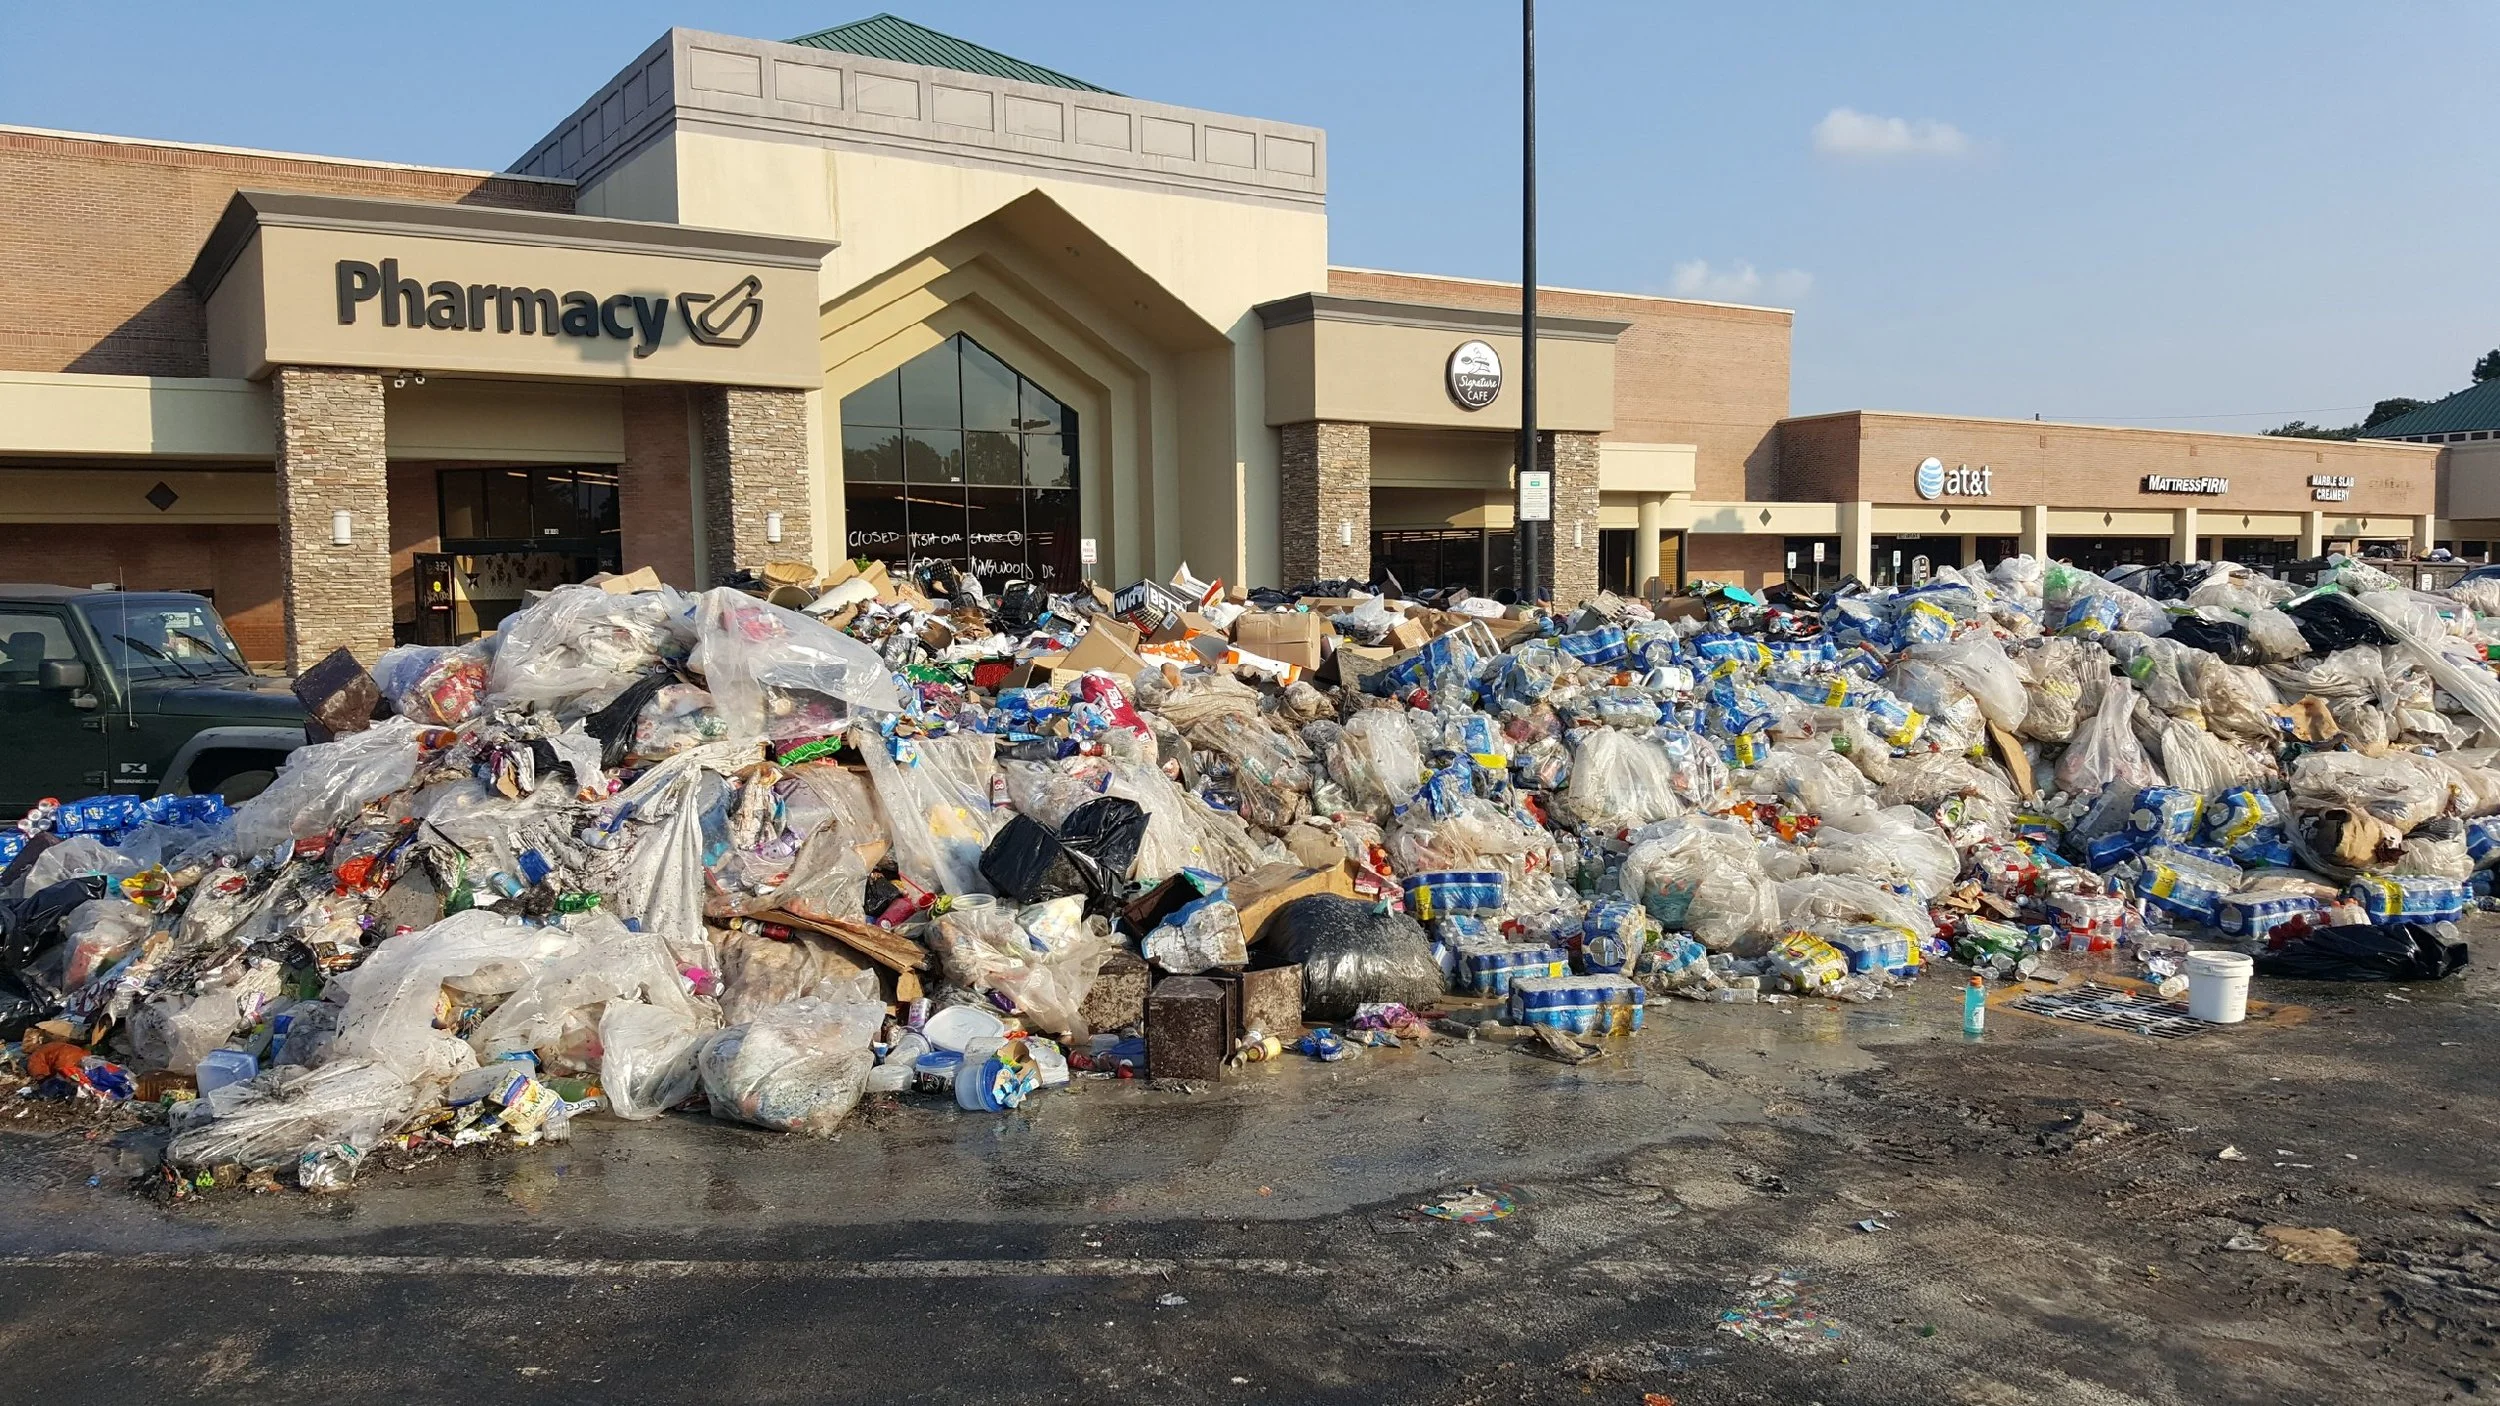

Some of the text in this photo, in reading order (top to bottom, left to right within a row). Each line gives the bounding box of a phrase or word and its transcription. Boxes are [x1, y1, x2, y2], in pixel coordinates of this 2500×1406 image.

[337, 257, 669, 358] Pharmacy
[1459, 375, 1497, 391] Signature
[1467, 391, 1488, 401] CAFE
[1946, 463, 1993, 496] at&t
[2312, 475, 2355, 488] MARBLE SLAB
[2316, 488, 2351, 501] CREAMERY
[940, 533, 963, 545] OUR
[1041, 563, 1056, 579] DR
[1115, 584, 1145, 613] WAY
